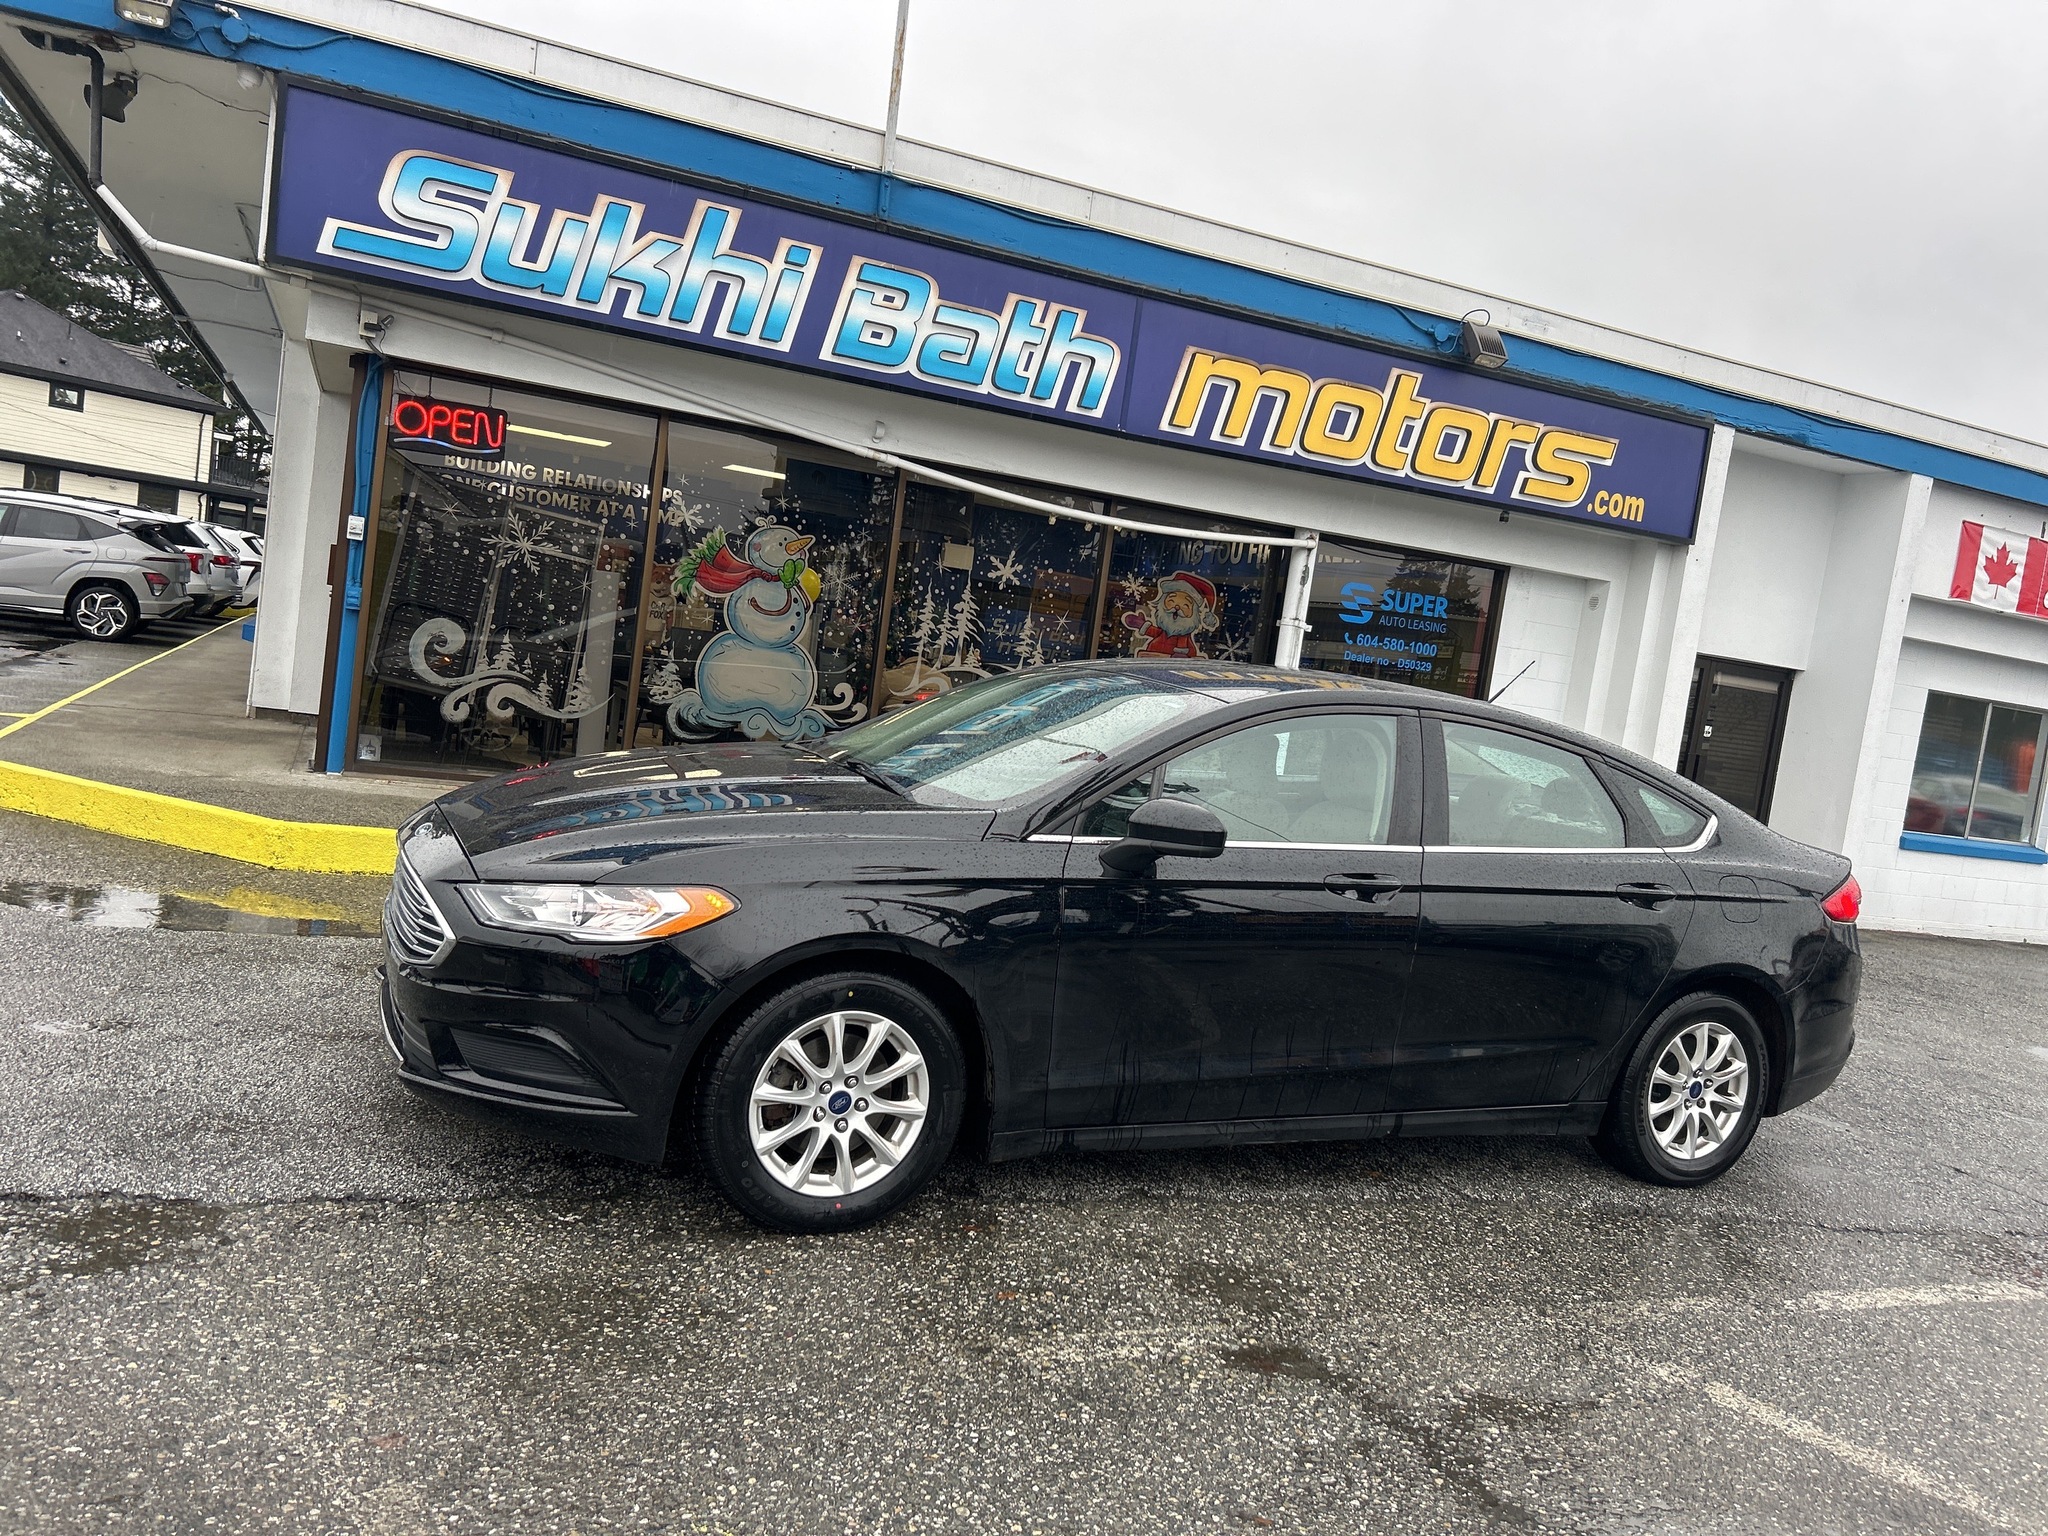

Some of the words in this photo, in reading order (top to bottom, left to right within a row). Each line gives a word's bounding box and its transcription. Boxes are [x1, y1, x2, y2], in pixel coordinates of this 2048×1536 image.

[317, 150, 823, 352] Sukhi
[819, 256, 1121, 418] Bath
[1158, 346, 1619, 508] motors
[395, 400, 504, 448] OPEN
[444, 455, 537, 481] BUILDING
[543, 466, 683, 505] RELATIONSHPS
[595, 499, 620, 517] AT
[622, 503, 636, 520] A
[649, 610, 664, 620] FOX
[1380, 587, 1448, 619] SUPER
[1379, 615, 1406, 628] AUTO
[1407, 619, 1447, 634] LEASING
[1356, 633, 1437, 657] 604-580-1000
[1344, 650, 1376, 664] Dealer
[1376, 657, 1389, 666] no
[1397, 658, 1432, 672] D50329
